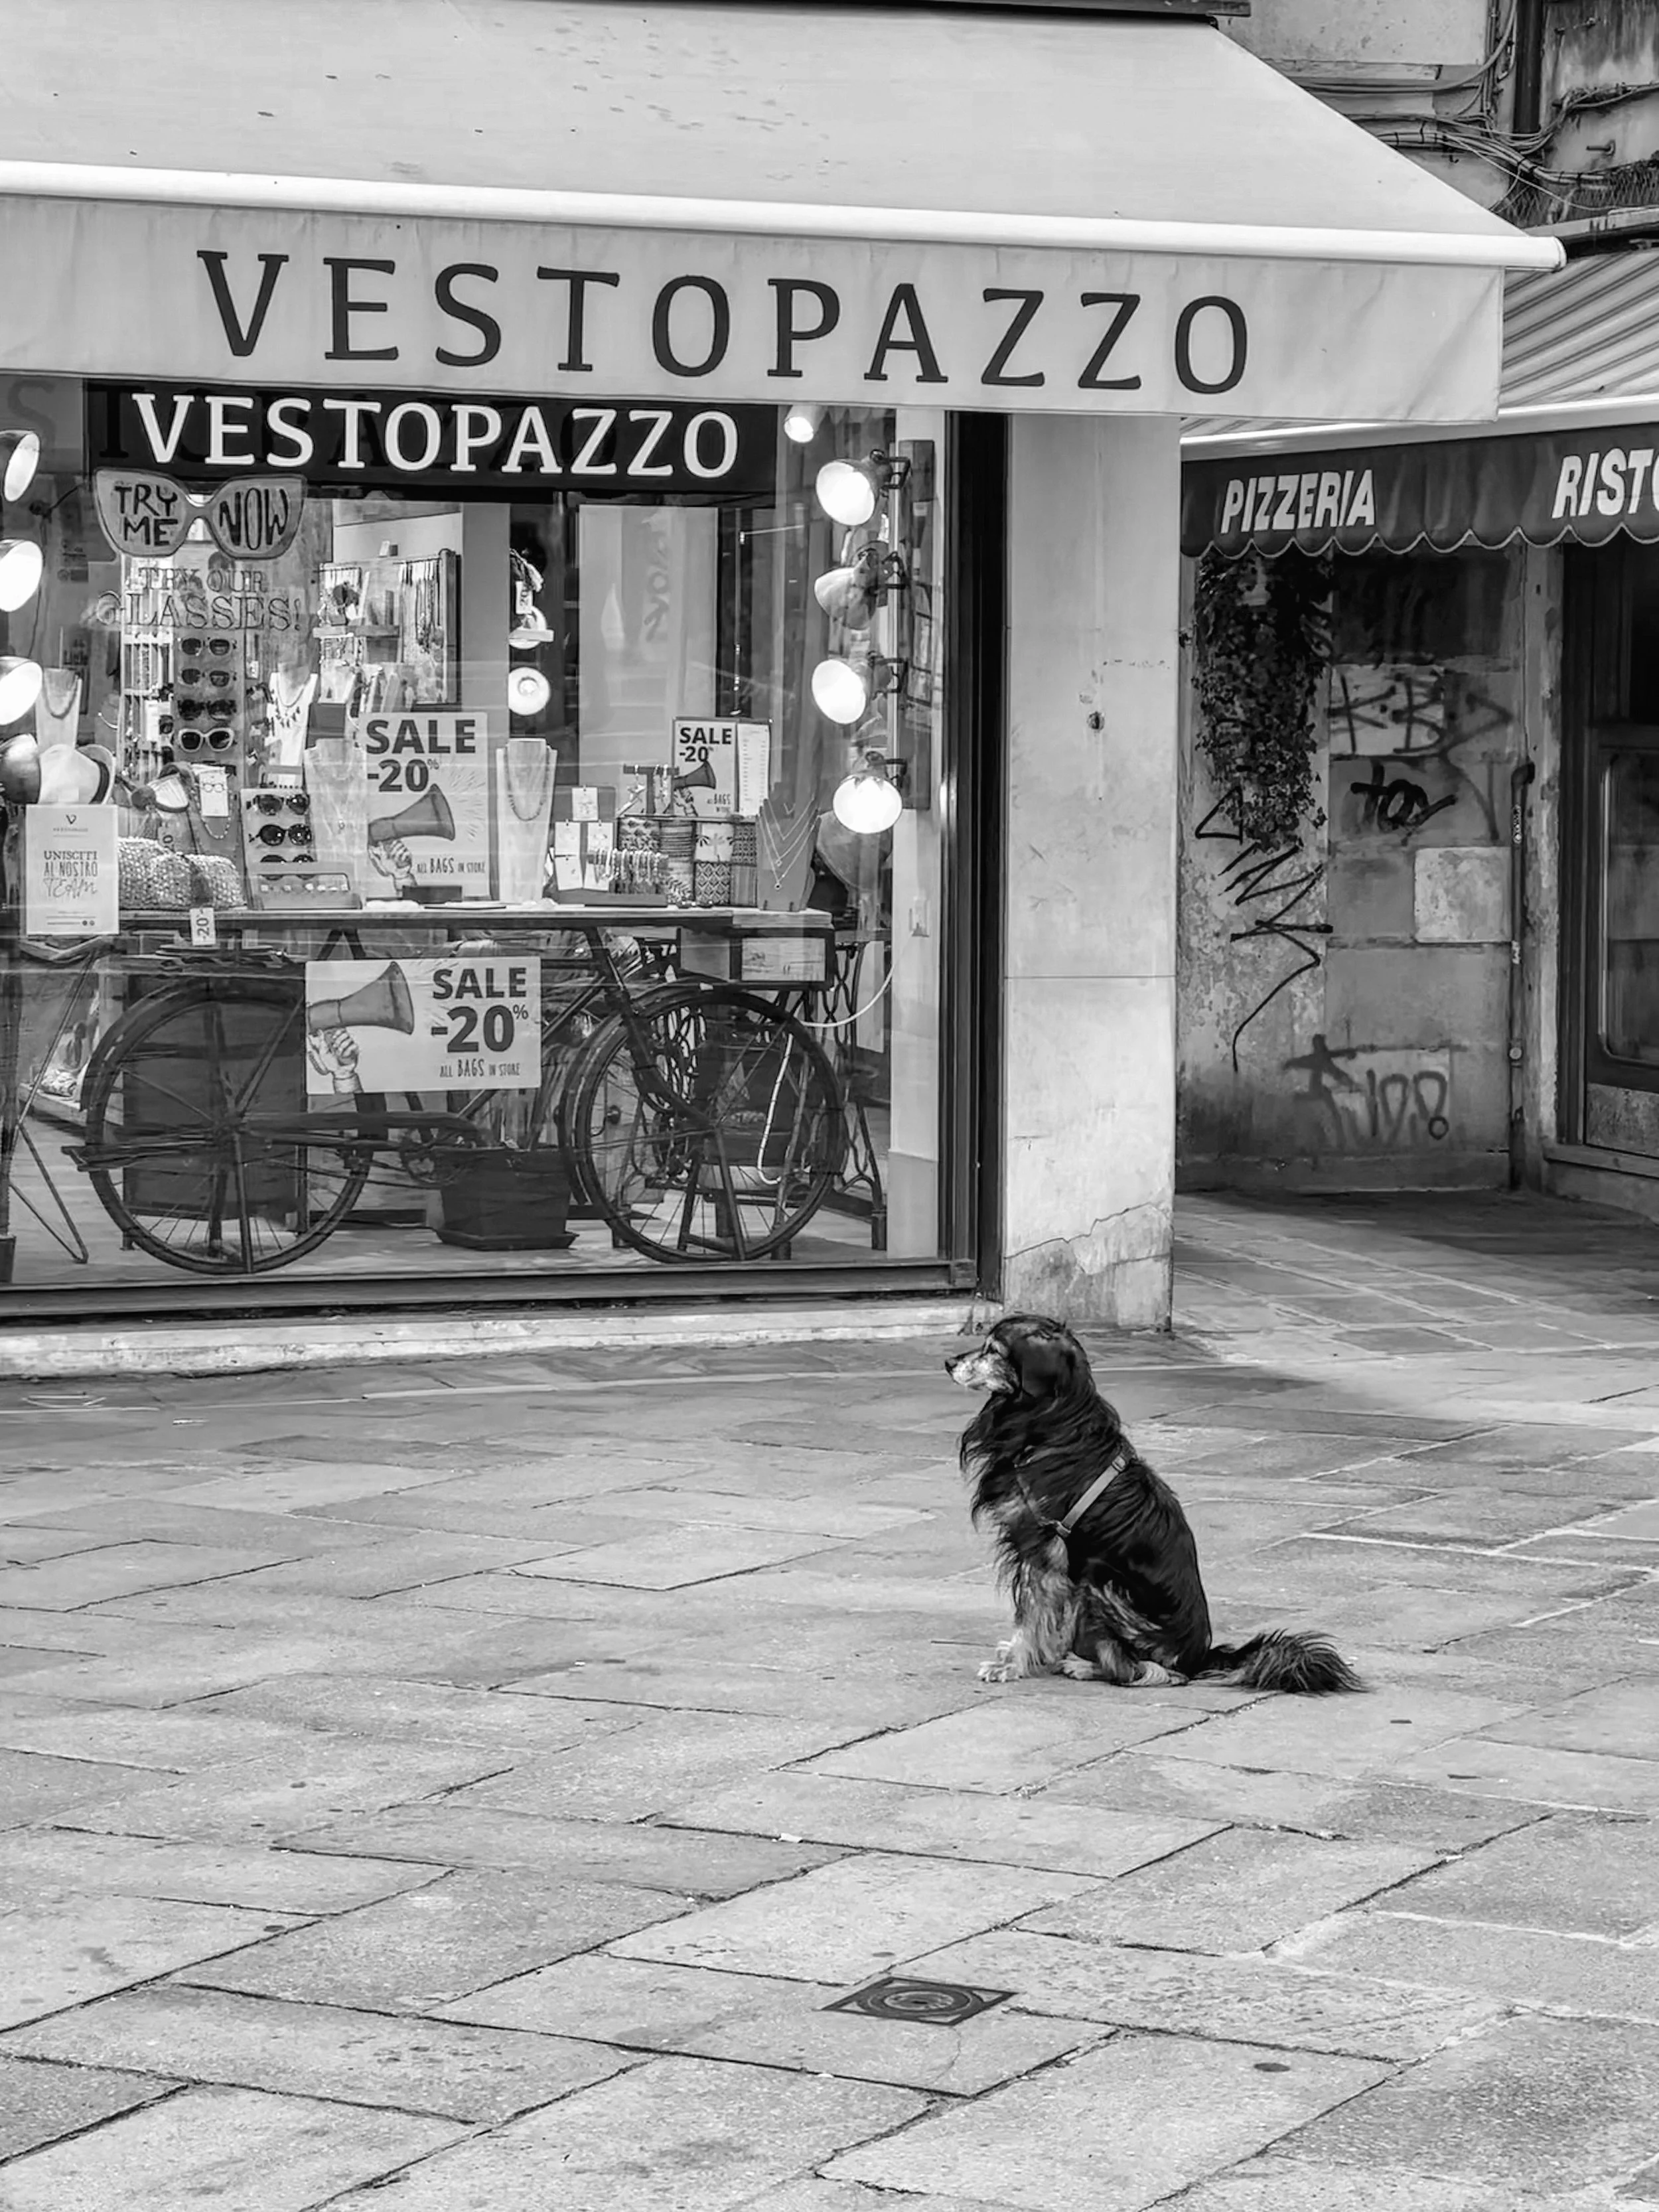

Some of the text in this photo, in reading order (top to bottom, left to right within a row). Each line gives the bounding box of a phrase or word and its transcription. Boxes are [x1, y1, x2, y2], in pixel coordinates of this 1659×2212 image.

[196, 250, 1247, 394] VESTOPAZZO
[132, 394, 737, 477] VESTOPAZZO
[113, 483, 178, 516] TRY
[1221, 469, 1375, 534] PIZZERIA
[124, 516, 179, 546] ME
[220, 487, 288, 550] NOW
[206, 570, 267, 593] OUR
[366, 719, 476, 755] SALE
[679, 727, 732, 745] SALE
[44, 850, 98, 861] UNISCITI
[44, 861, 98, 877] AL NOSTRO
[432, 968, 527, 999] SALE
[431, 1004, 529, 1053] -20%
[440, 1059, 520, 1078] ALL BAGS IN STORE
